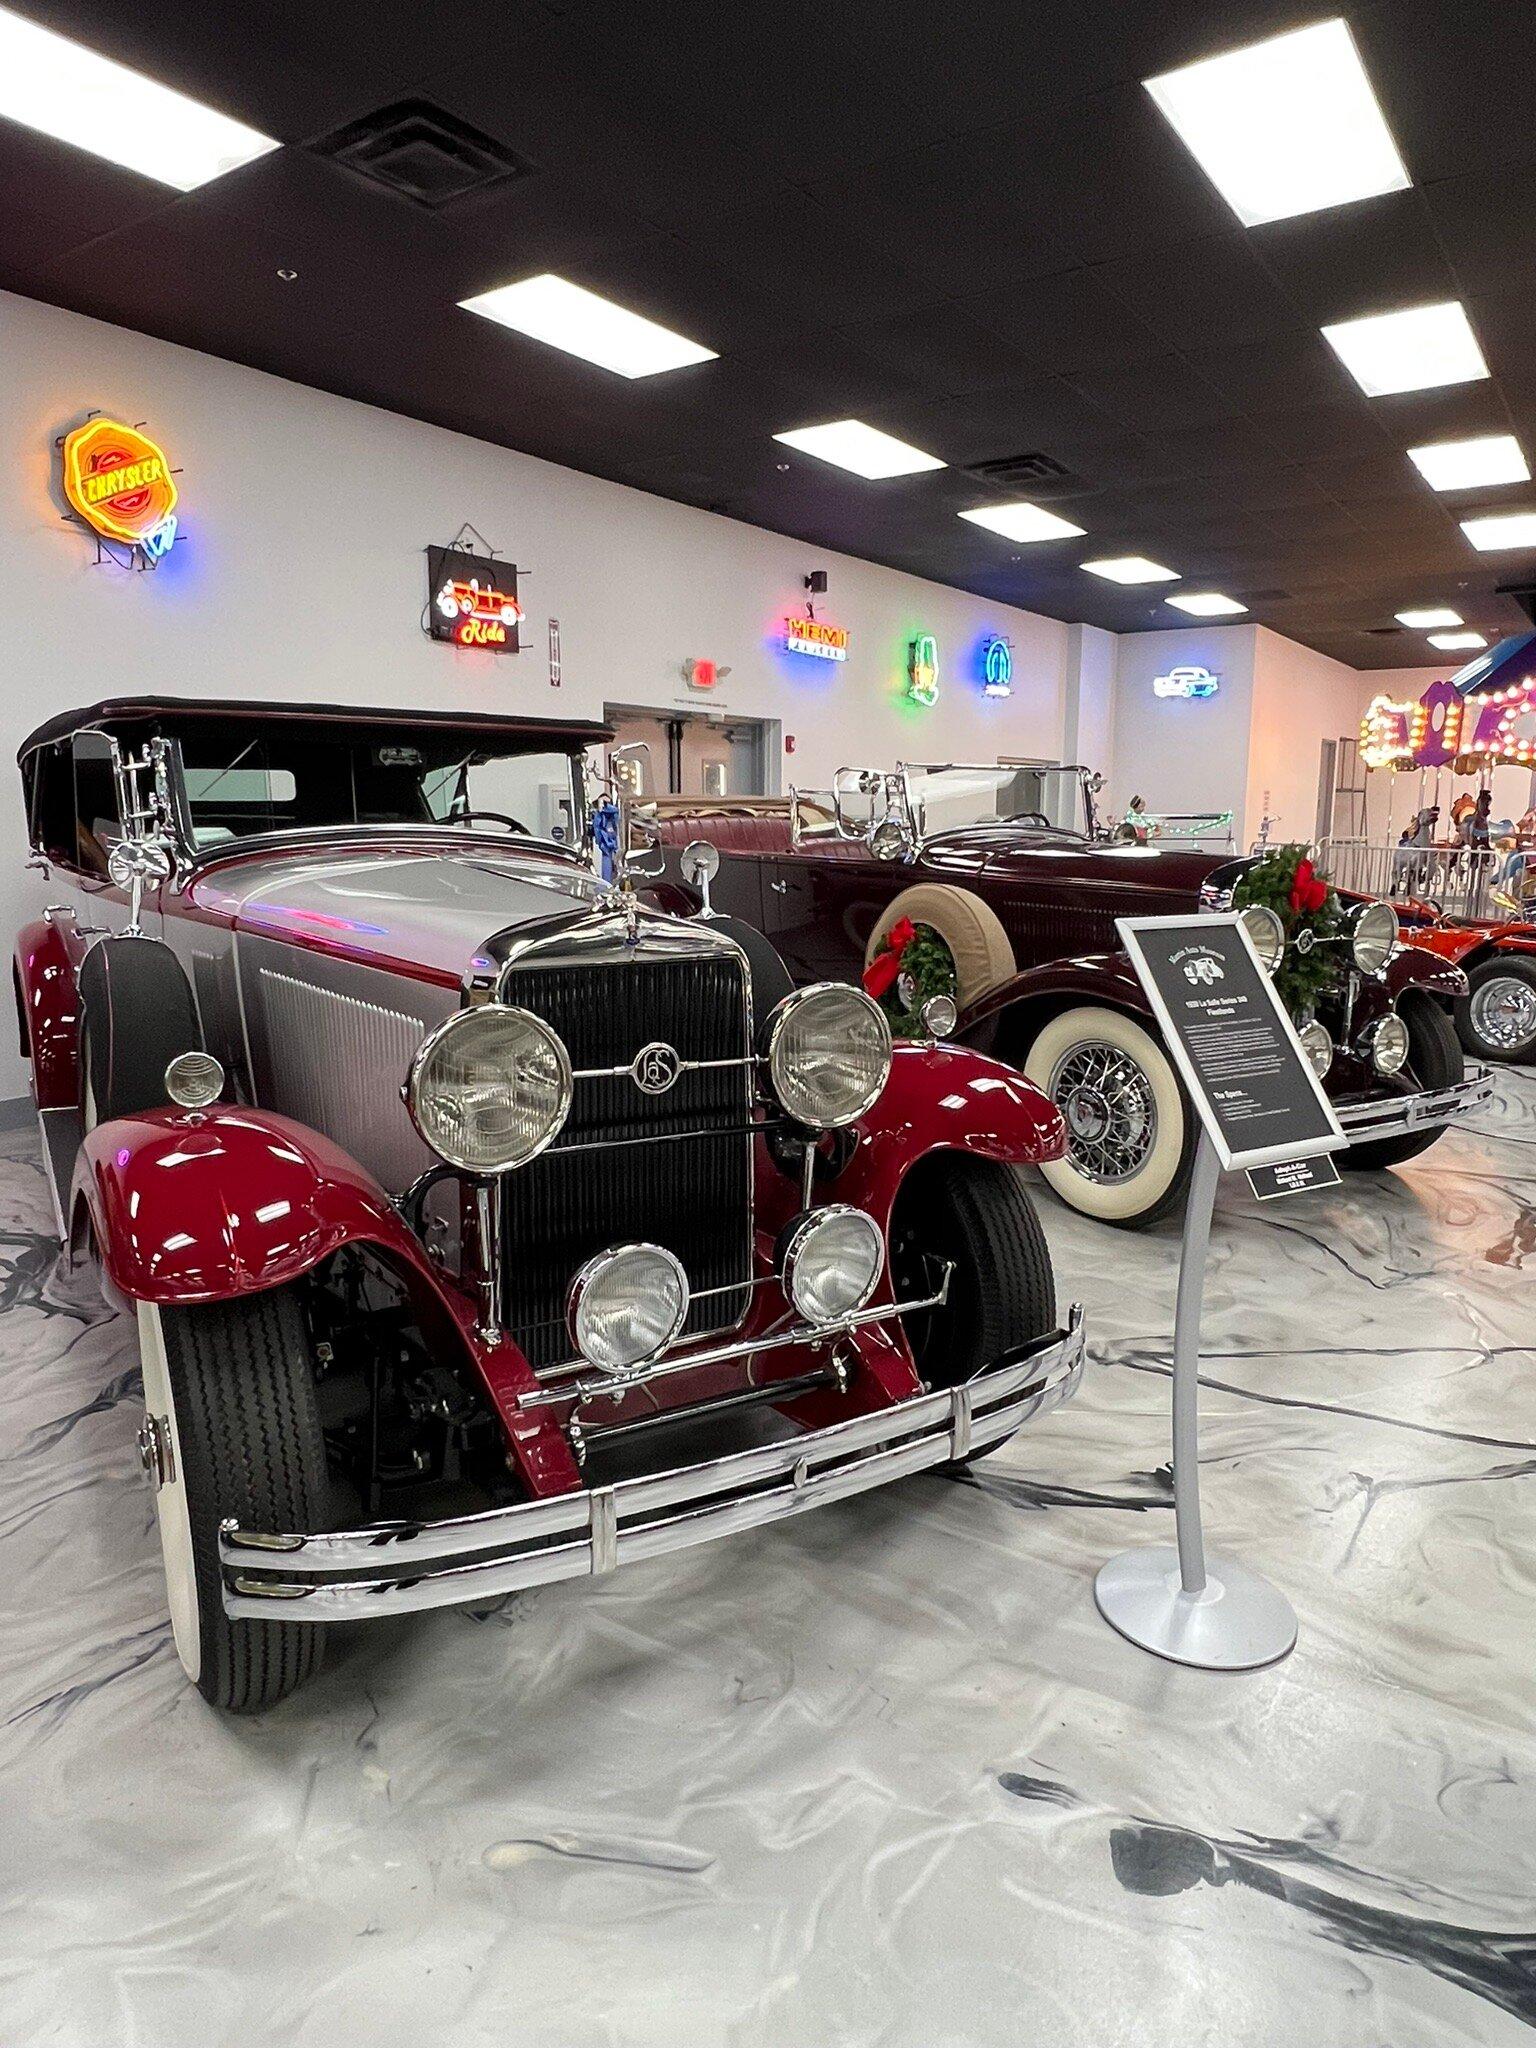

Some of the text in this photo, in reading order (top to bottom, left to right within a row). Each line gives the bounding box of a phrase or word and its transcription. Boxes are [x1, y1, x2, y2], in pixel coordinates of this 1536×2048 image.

[87, 458, 162, 502] CHRYSLER
[461, 617, 506, 644] Ride
[788, 618, 847, 648] HEMI
